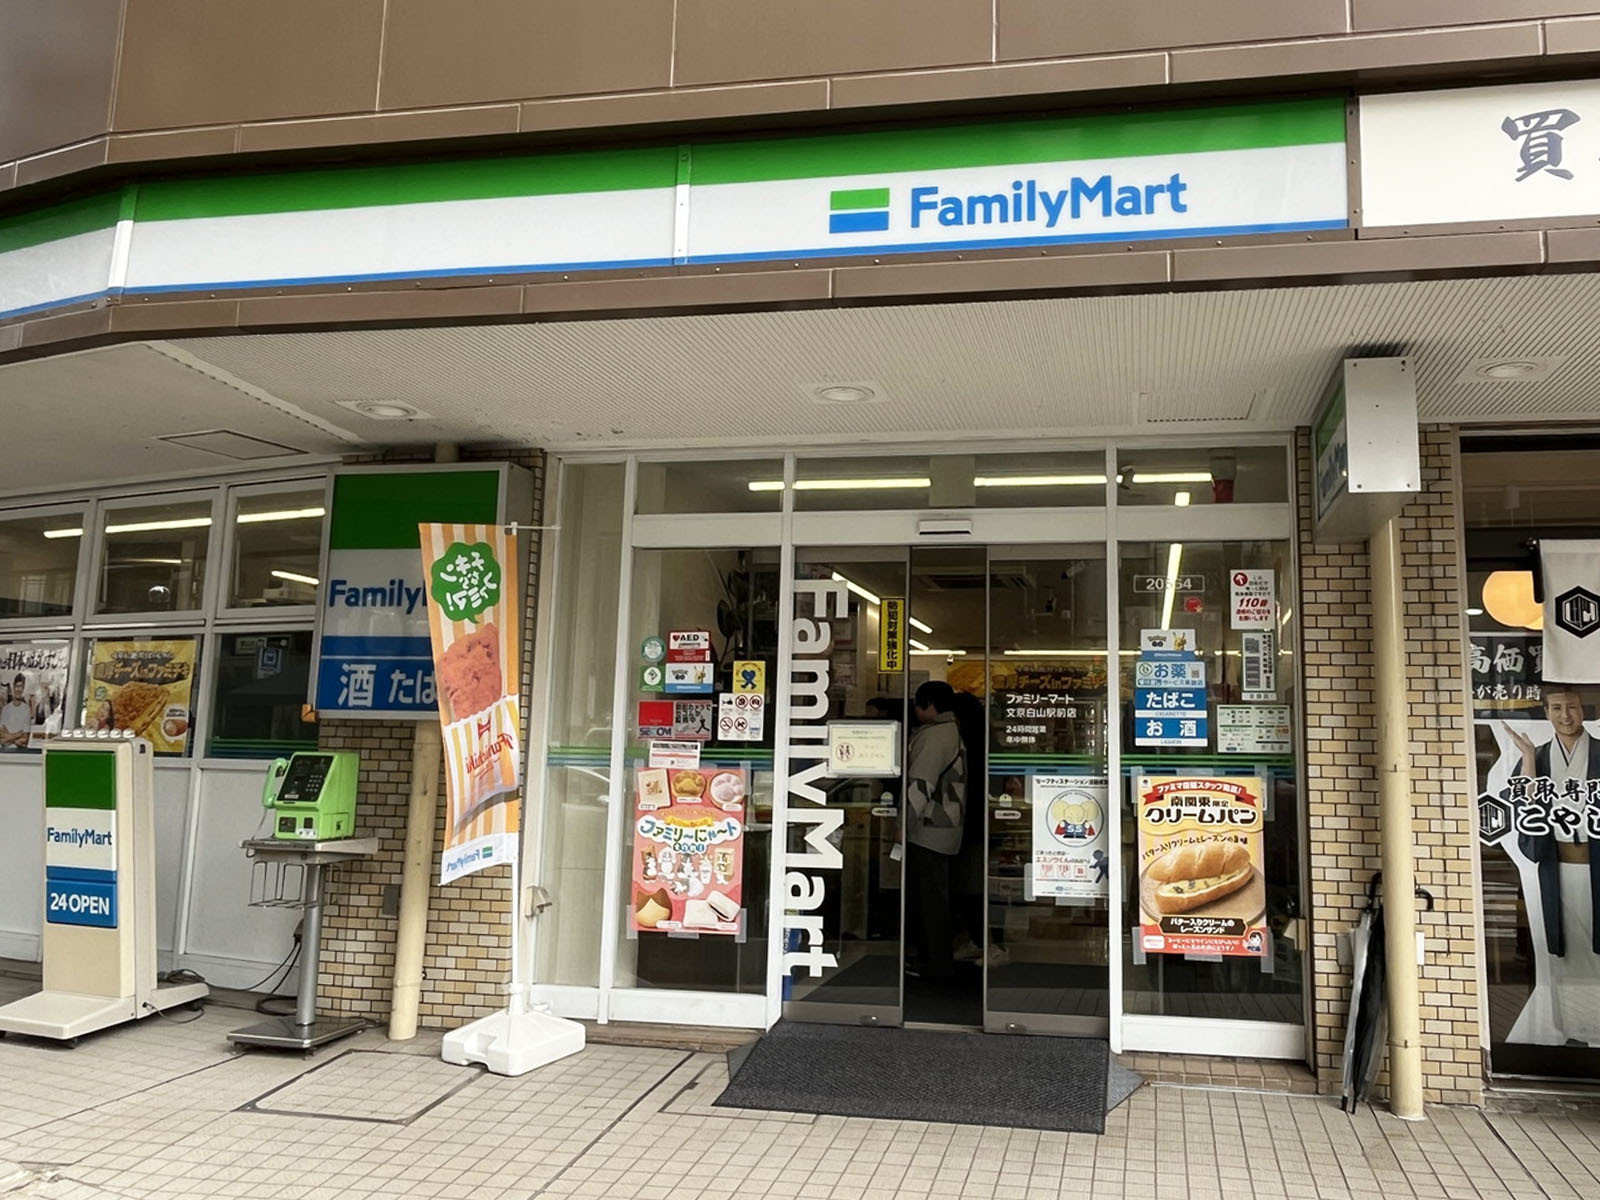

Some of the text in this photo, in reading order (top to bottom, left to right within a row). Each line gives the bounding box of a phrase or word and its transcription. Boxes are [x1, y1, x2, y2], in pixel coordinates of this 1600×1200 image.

[1501, 109, 1581, 182] 買
[911, 173, 1188, 229] FamilyMart
[329, 579, 427, 615] Family
[337, 663, 377, 708] 酒
[1006, 694, 1074, 705] ファミリーマート
[1472, 684, 1541, 700] が売り時
[1146, 692, 1195, 708] たばこ
[782, 579, 849, 978] FamilyMart
[1145, 808, 1257, 824] クリームパン
[47, 827, 112, 848] FamilyMart
